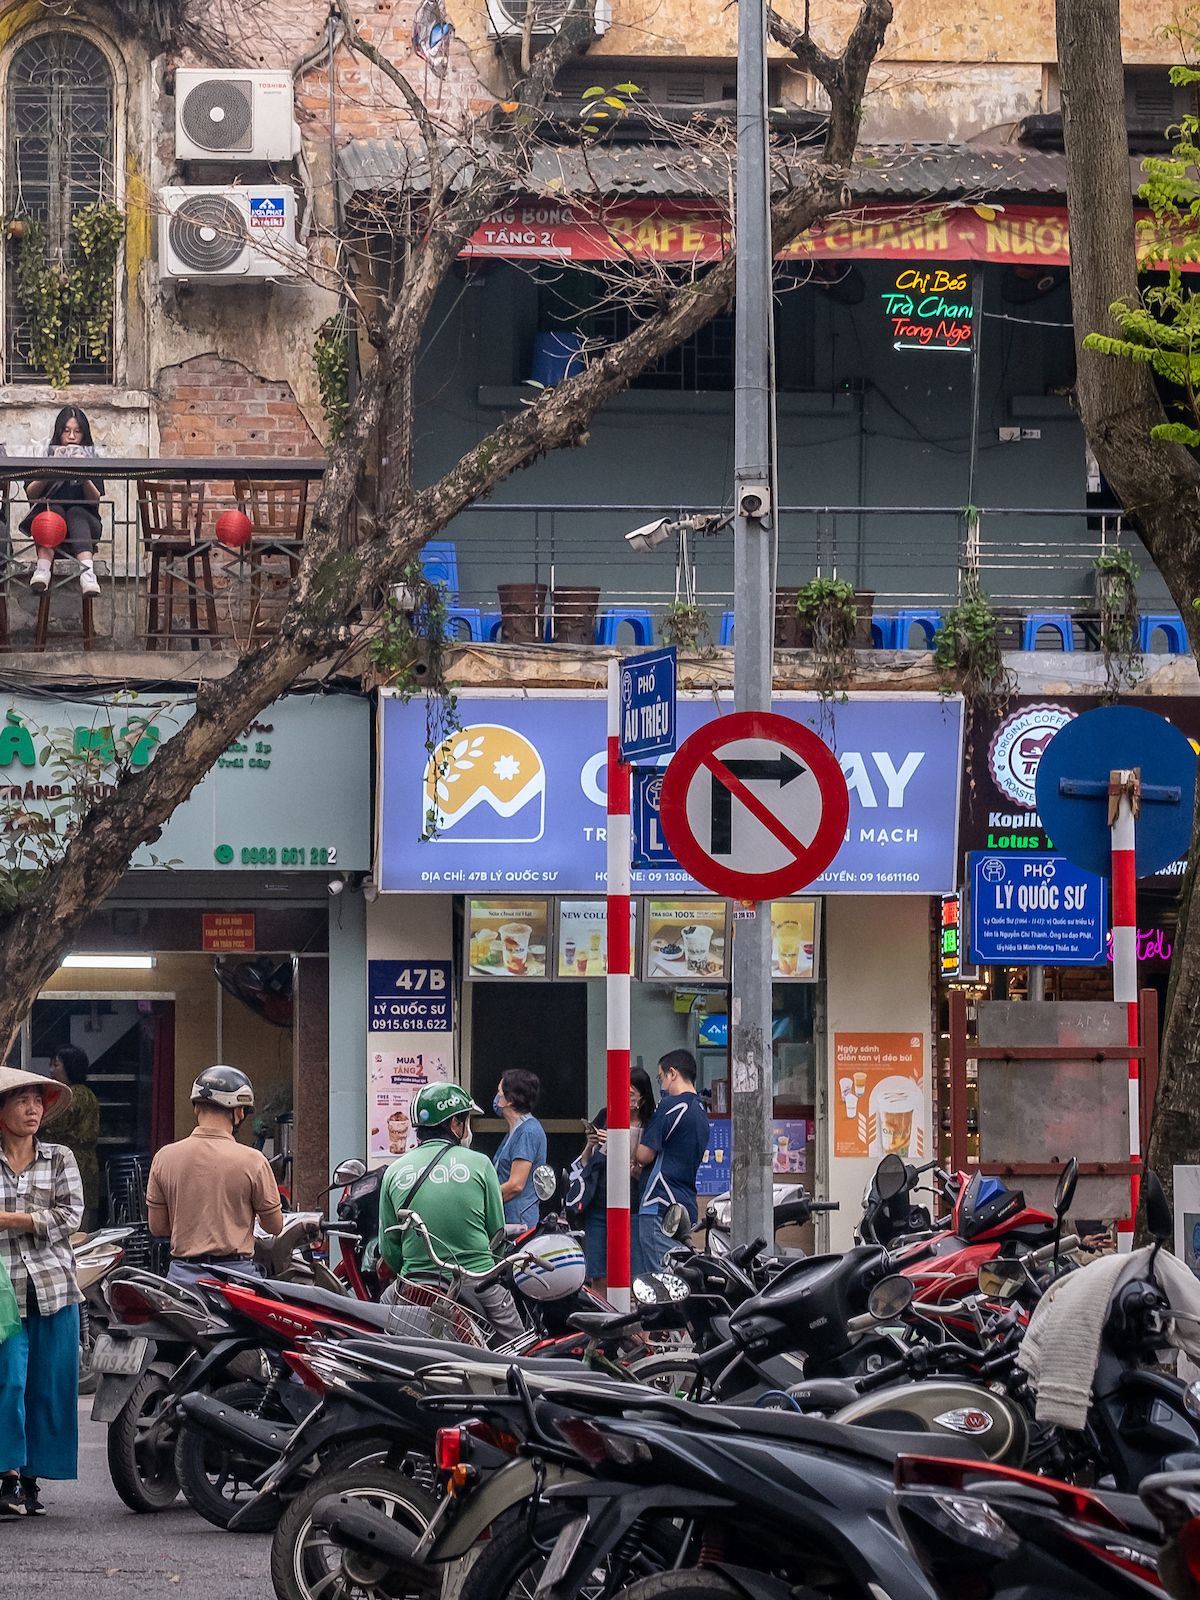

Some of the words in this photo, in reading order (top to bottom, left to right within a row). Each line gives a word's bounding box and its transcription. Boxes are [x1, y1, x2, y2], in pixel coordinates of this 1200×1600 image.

[540, 232, 551, 244] 2
[896, 270, 930, 293] Chị
[930, 270, 967, 291] Béo
[882, 294, 913, 316] Trà
[891, 318, 933, 344] Trong
[935, 321, 972, 347] Ngõ
[637, 665, 656, 695] PHỐ
[640, 695, 669, 743] TRIỆU
[997, 719, 1032, 758] ORIGINAL
[861, 829, 918, 846] MẠCH
[988, 834, 1039, 849] Lotus
[1023, 858, 1056, 877] PHỐ
[421, 872, 441, 884] ĐỊA
[443, 869, 465, 881] CHỈ:
[468, 872, 487, 881] 47B
[490, 869, 502, 881] LÝ
[506, 869, 539, 882] QUỐC
[542, 871, 558, 881] SƯ
[648, 872, 662, 881] 09
[860, 873, 873, 882] 09
[877, 873, 919, 882] 16611160
[995, 880, 1014, 909] LÝ
[1018, 878, 1059, 912] QUỐC
[1064, 884, 1088, 910] SƯ
[395, 968, 446, 990] 47B
[374, 1002, 387, 1014] LÝ
[390, 1001, 427, 1014] QUỐC
[431, 1003, 446, 1014] SƯ
[372, 1019, 447, 1029] 0915.618.622
[837, 1045, 858, 1053] Ngậy
[860, 1045, 879, 1053] sánh
[417, 1054, 423, 1066] 1
[416, 1065, 424, 1077] 2
[436, 1094, 461, 1111] Grab
